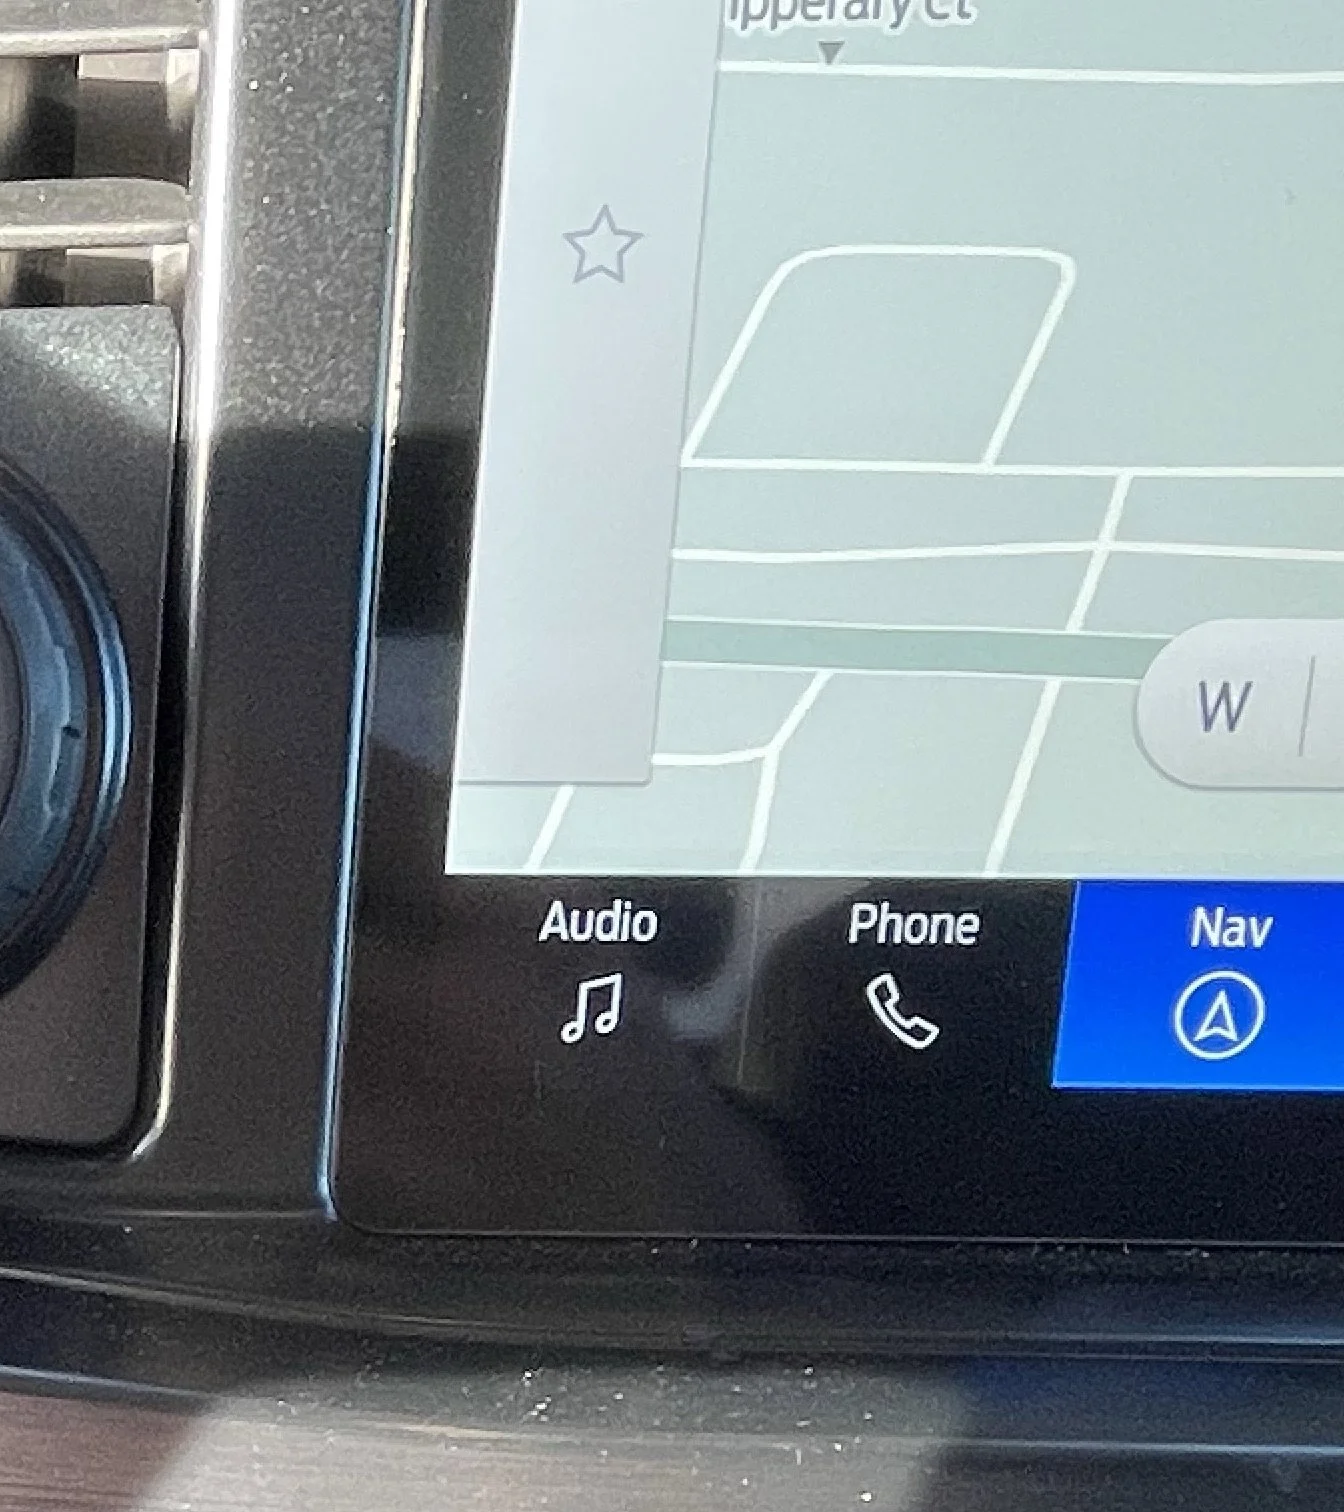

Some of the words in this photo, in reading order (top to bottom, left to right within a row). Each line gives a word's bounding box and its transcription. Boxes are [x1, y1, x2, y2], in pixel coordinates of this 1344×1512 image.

[1198, 680, 1254, 733] W
[538, 900, 658, 943] Audio
[849, 902, 980, 945] Phone
[1191, 907, 1273, 947] Nav
